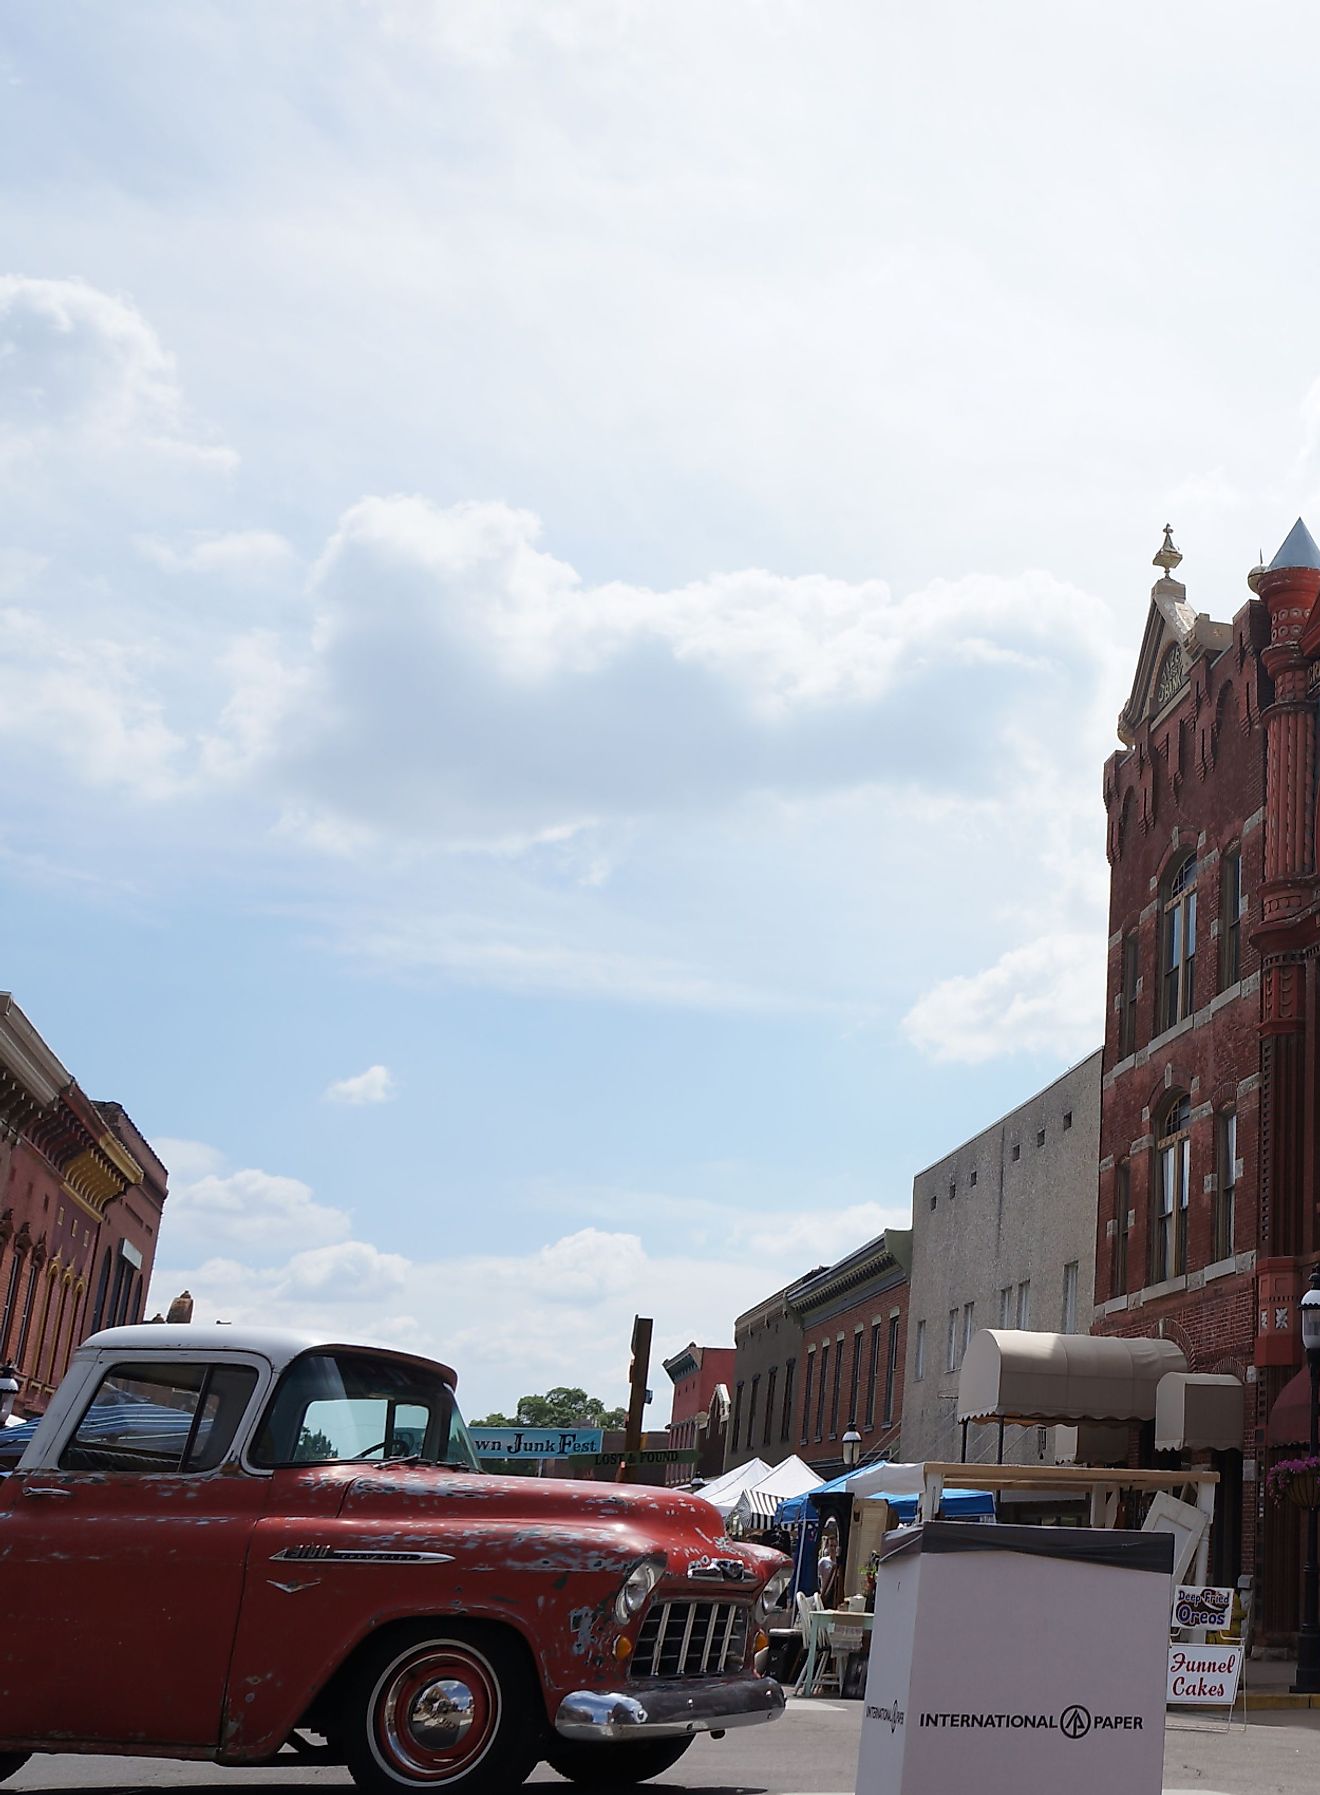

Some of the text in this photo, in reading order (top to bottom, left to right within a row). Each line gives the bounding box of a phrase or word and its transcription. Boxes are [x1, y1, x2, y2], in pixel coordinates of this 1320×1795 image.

[507, 1433, 555, 1454] Junk
[557, 1433, 597, 1454] Fest
[595, 1454, 622, 1466] LOST
[640, 1451, 678, 1463] FOUND
[1178, 1590, 1230, 1607] Deep Fried
[1178, 1604, 1226, 1626] Oreos
[1170, 1652, 1236, 1674] Funnel
[1172, 1676, 1225, 1697] Cakes
[919, 1713, 1143, 1730] INTERNATIONAL PAPER
